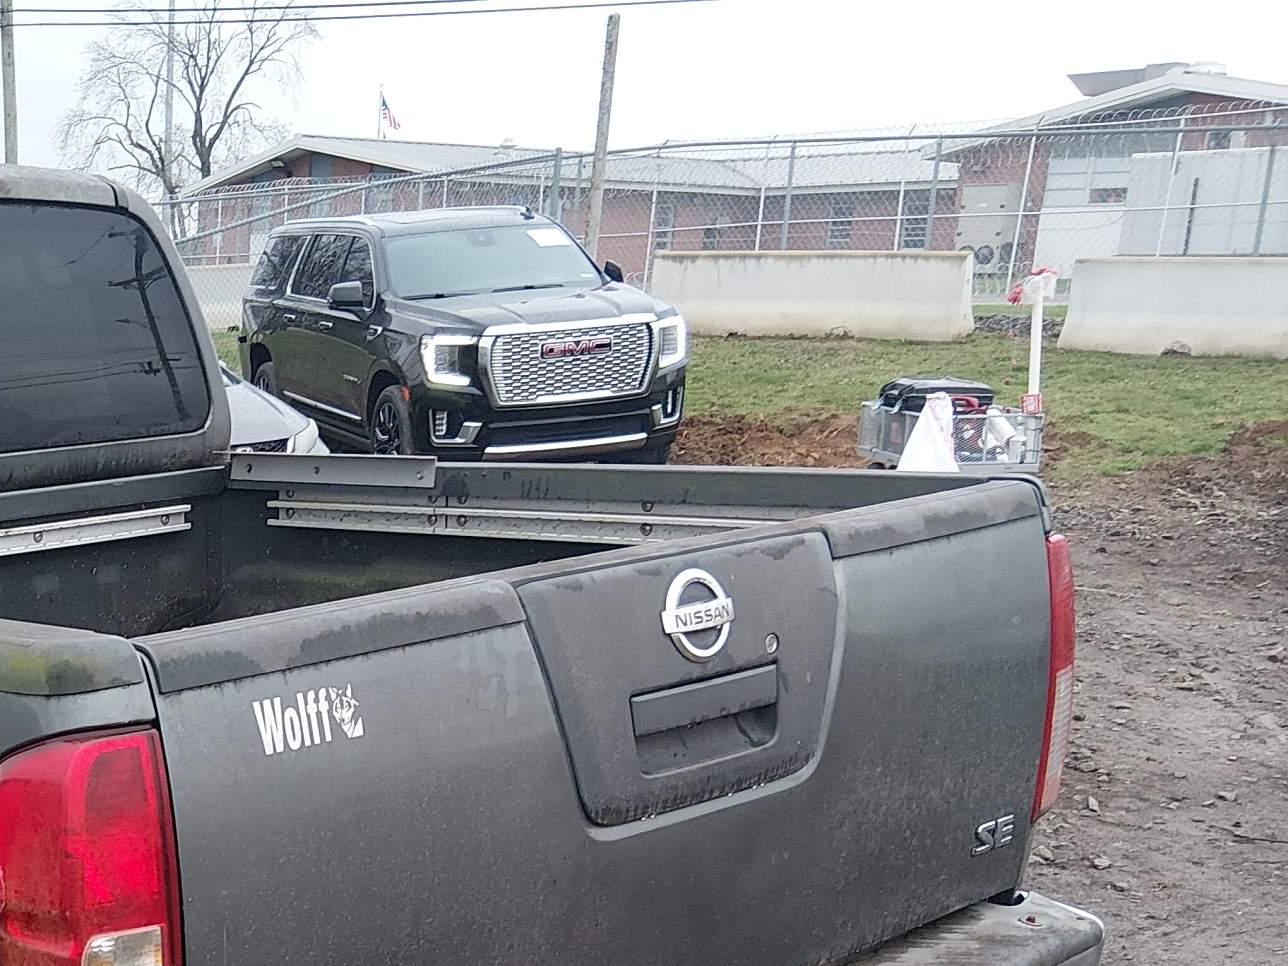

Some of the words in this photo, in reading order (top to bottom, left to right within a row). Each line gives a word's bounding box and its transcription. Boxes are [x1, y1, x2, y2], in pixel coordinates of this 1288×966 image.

[542, 338, 611, 358] GMC
[675, 603, 730, 629] NISSAN
[252, 687, 332, 756] Wolff
[971, 814, 1015, 857] SE
